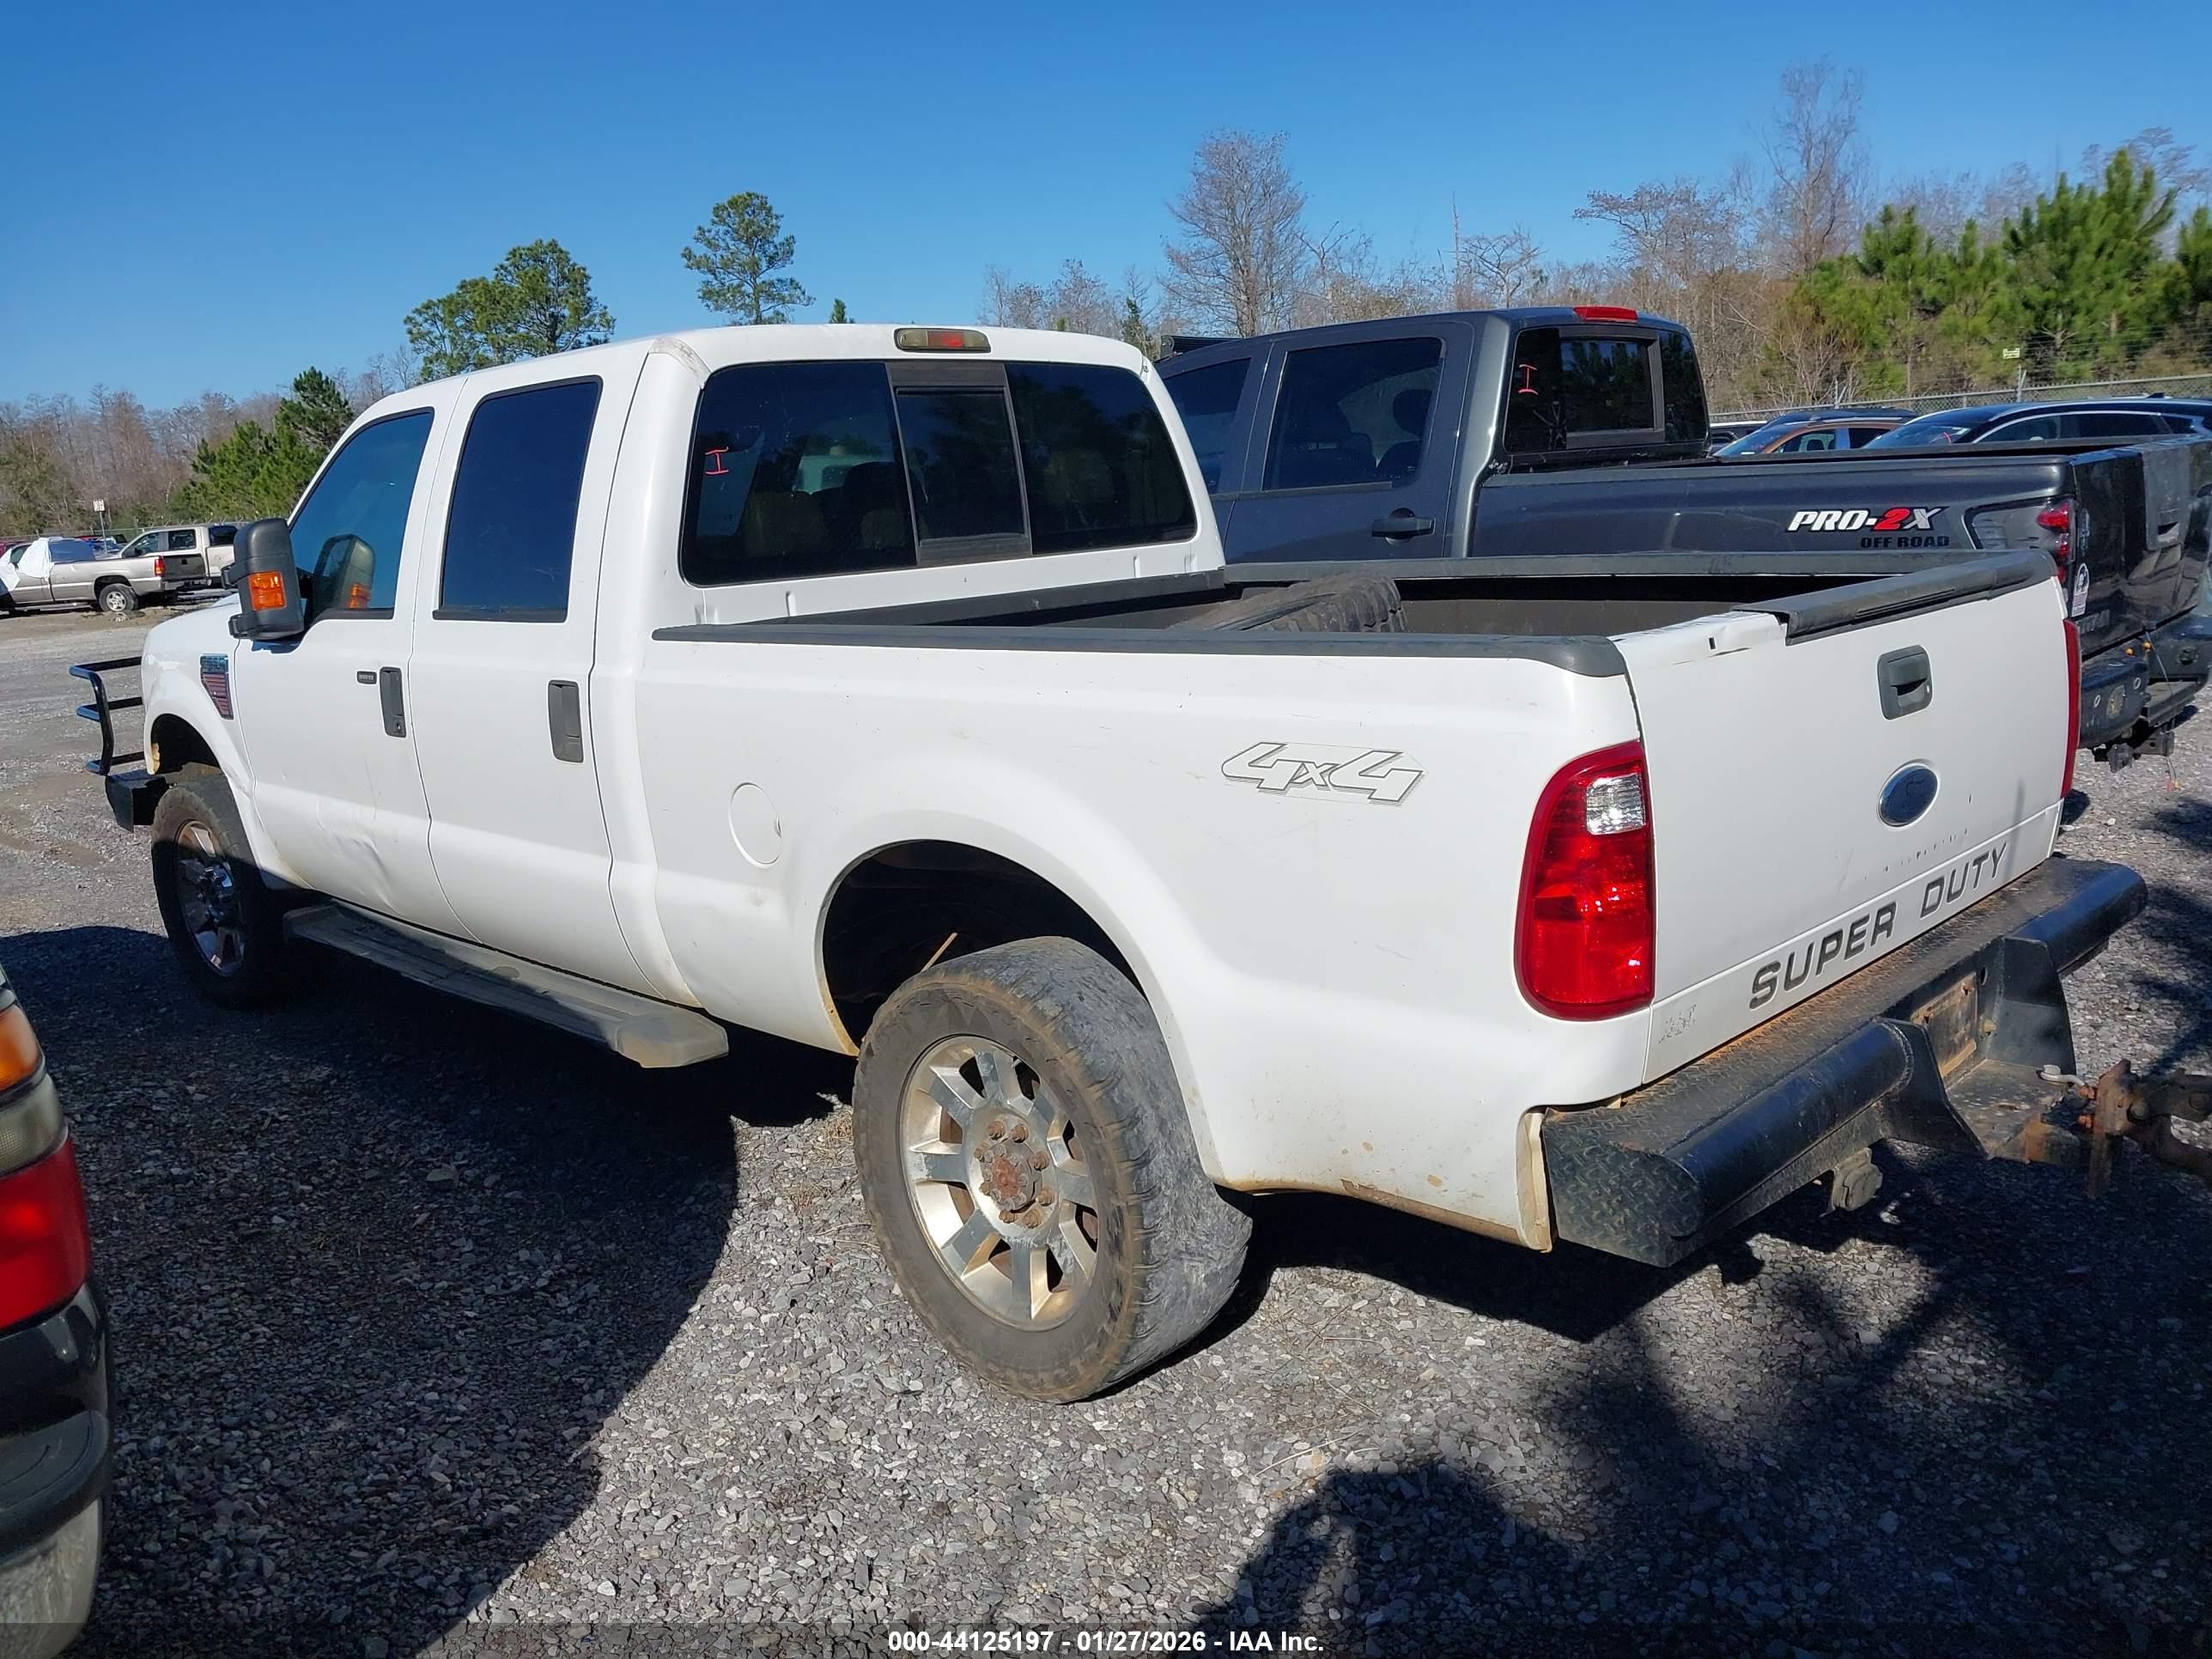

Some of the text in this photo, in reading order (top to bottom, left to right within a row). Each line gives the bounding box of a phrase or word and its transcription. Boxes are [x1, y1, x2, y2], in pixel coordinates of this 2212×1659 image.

[1786, 506, 1948, 532] PRO-2X
[1860, 535, 1949, 549] OFF ROAD
[1748, 841, 2008, 1011] SUPER DUTY
